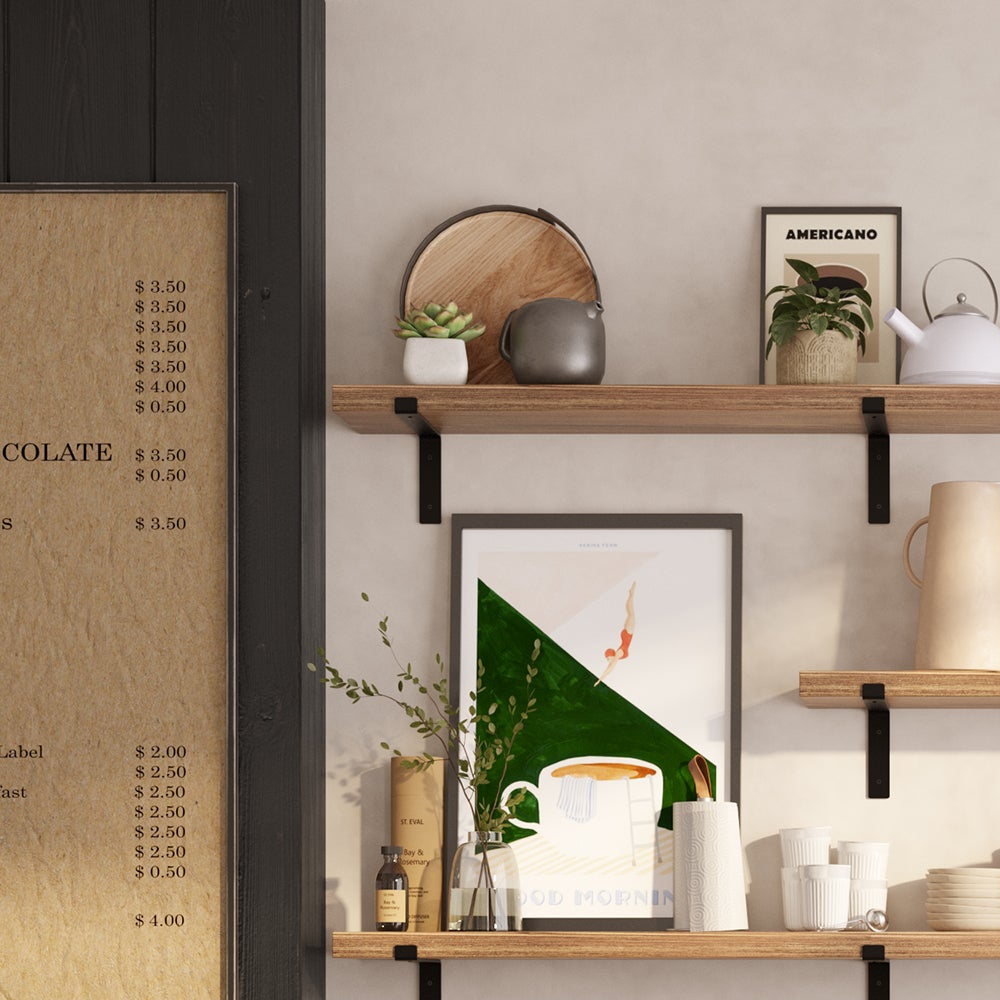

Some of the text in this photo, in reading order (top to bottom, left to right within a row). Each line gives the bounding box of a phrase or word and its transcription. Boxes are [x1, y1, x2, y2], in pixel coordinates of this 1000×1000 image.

[786, 229, 877, 240] AMERICANO
[136, 280, 185, 294] $ 3.50
[135, 300, 186, 314] $ 3.50
[136, 320, 186, 335] $ 3.50
[136, 340, 186, 354] $ 3.50
[136, 360, 186, 374] $ 3.50
[135, 380, 186, 394] $ 4.00
[136, 400, 186, 414] $ 0.50
[2, 443, 113, 461] COLATE
[136, 448, 186, 463] $ 3.50
[136, 469, 186, 483] $ 0.50
[136, 517, 186, 531] $ 3.50
[136, 745, 186, 759] $ 2.00
[136, 766, 186, 779] $ 2.50
[135, 785, 185, 799] $ 2.50
[135, 805, 185, 819] $ 2.50
[135, 825, 185, 840] $ 2.50
[135, 845, 185, 860] $ 2.50
[403, 849, 415, 857] Bay
[135, 865, 185, 880] $ 0.50
[574, 889, 673, 905] MORNIN
[135, 914, 184, 928] $ 4.00
